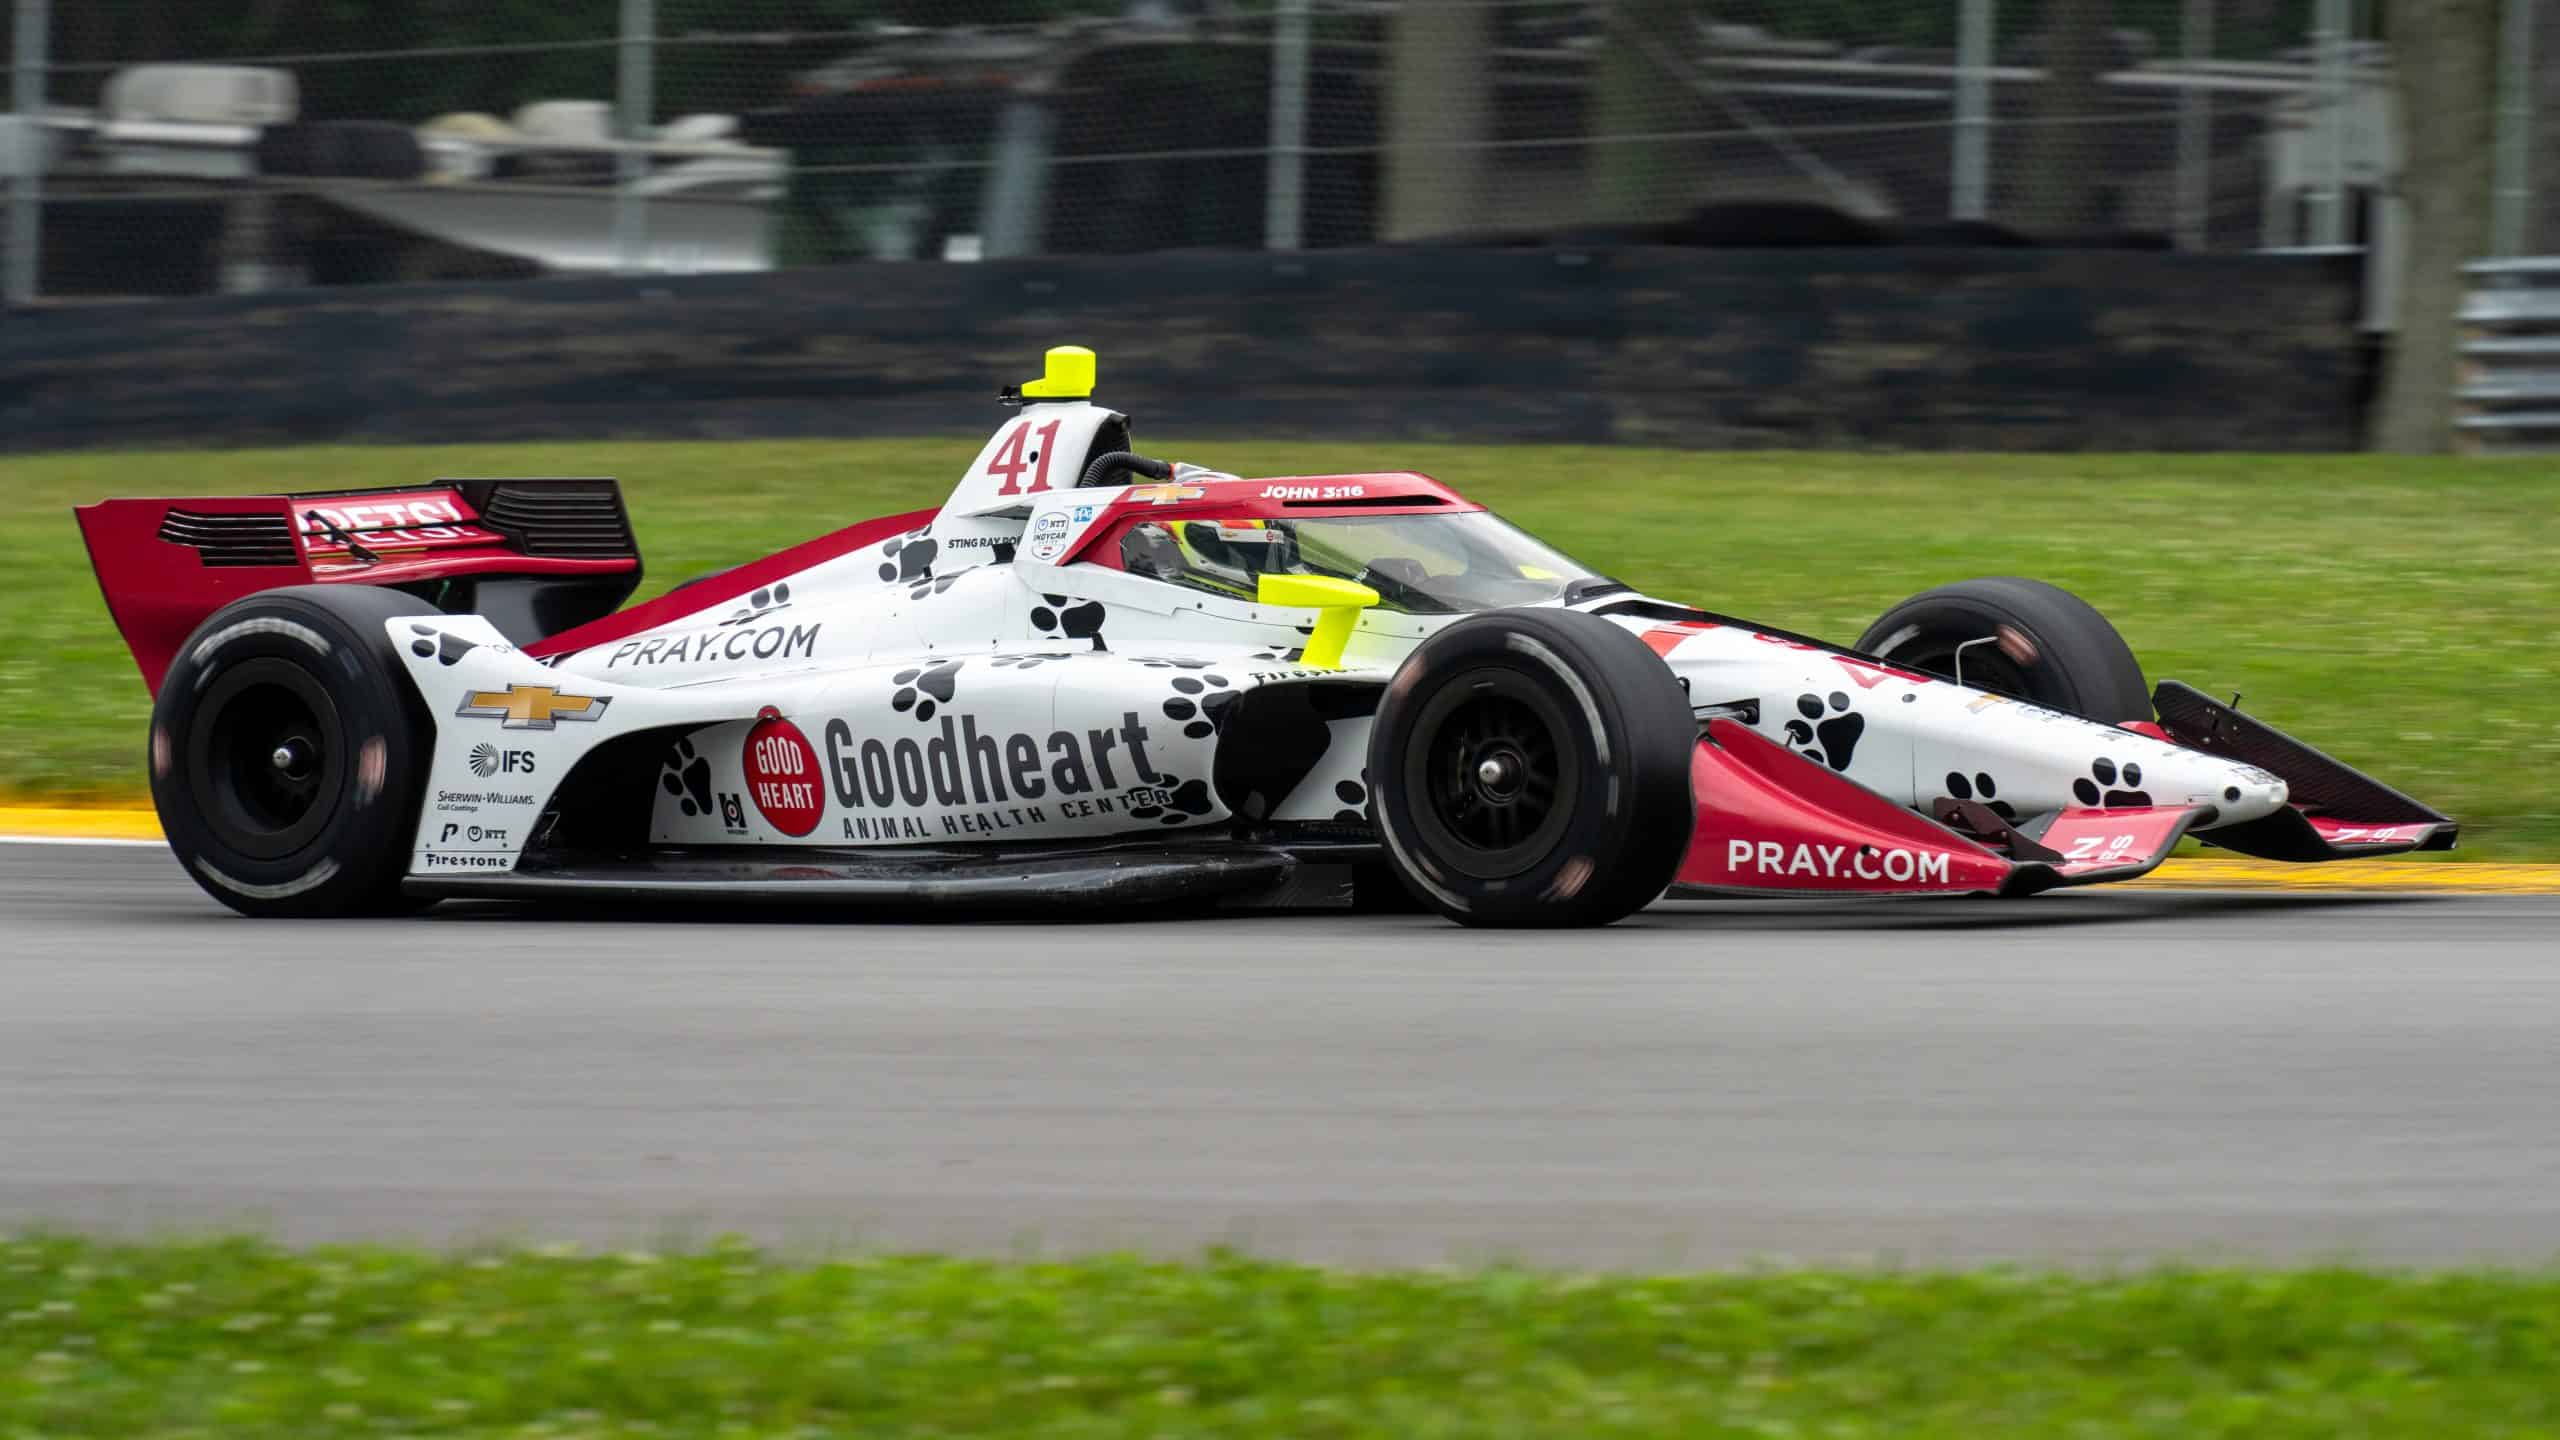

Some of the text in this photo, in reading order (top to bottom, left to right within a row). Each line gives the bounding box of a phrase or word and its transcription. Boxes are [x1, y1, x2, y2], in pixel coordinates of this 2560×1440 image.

[986, 419, 1060, 496] 41
[1260, 486, 1364, 498] JOHN 3:16
[948, 538, 978, 549] STING
[980, 537, 1000, 547] RAY
[1033, 532, 1067, 542] INDYCAR
[607, 623, 822, 668] PRAY.COM
[502, 750, 536, 773] IFS
[756, 736, 804, 775] GOOD
[826, 712, 1161, 809] Goodheart
[758, 783, 814, 810] HEART
[843, 789, 1172, 840] ANIMAL HEALTH CENTER
[484, 829, 507, 840] NTT
[425, 853, 508, 868] Firestone
[1727, 839, 1950, 884] PRAY.COM
